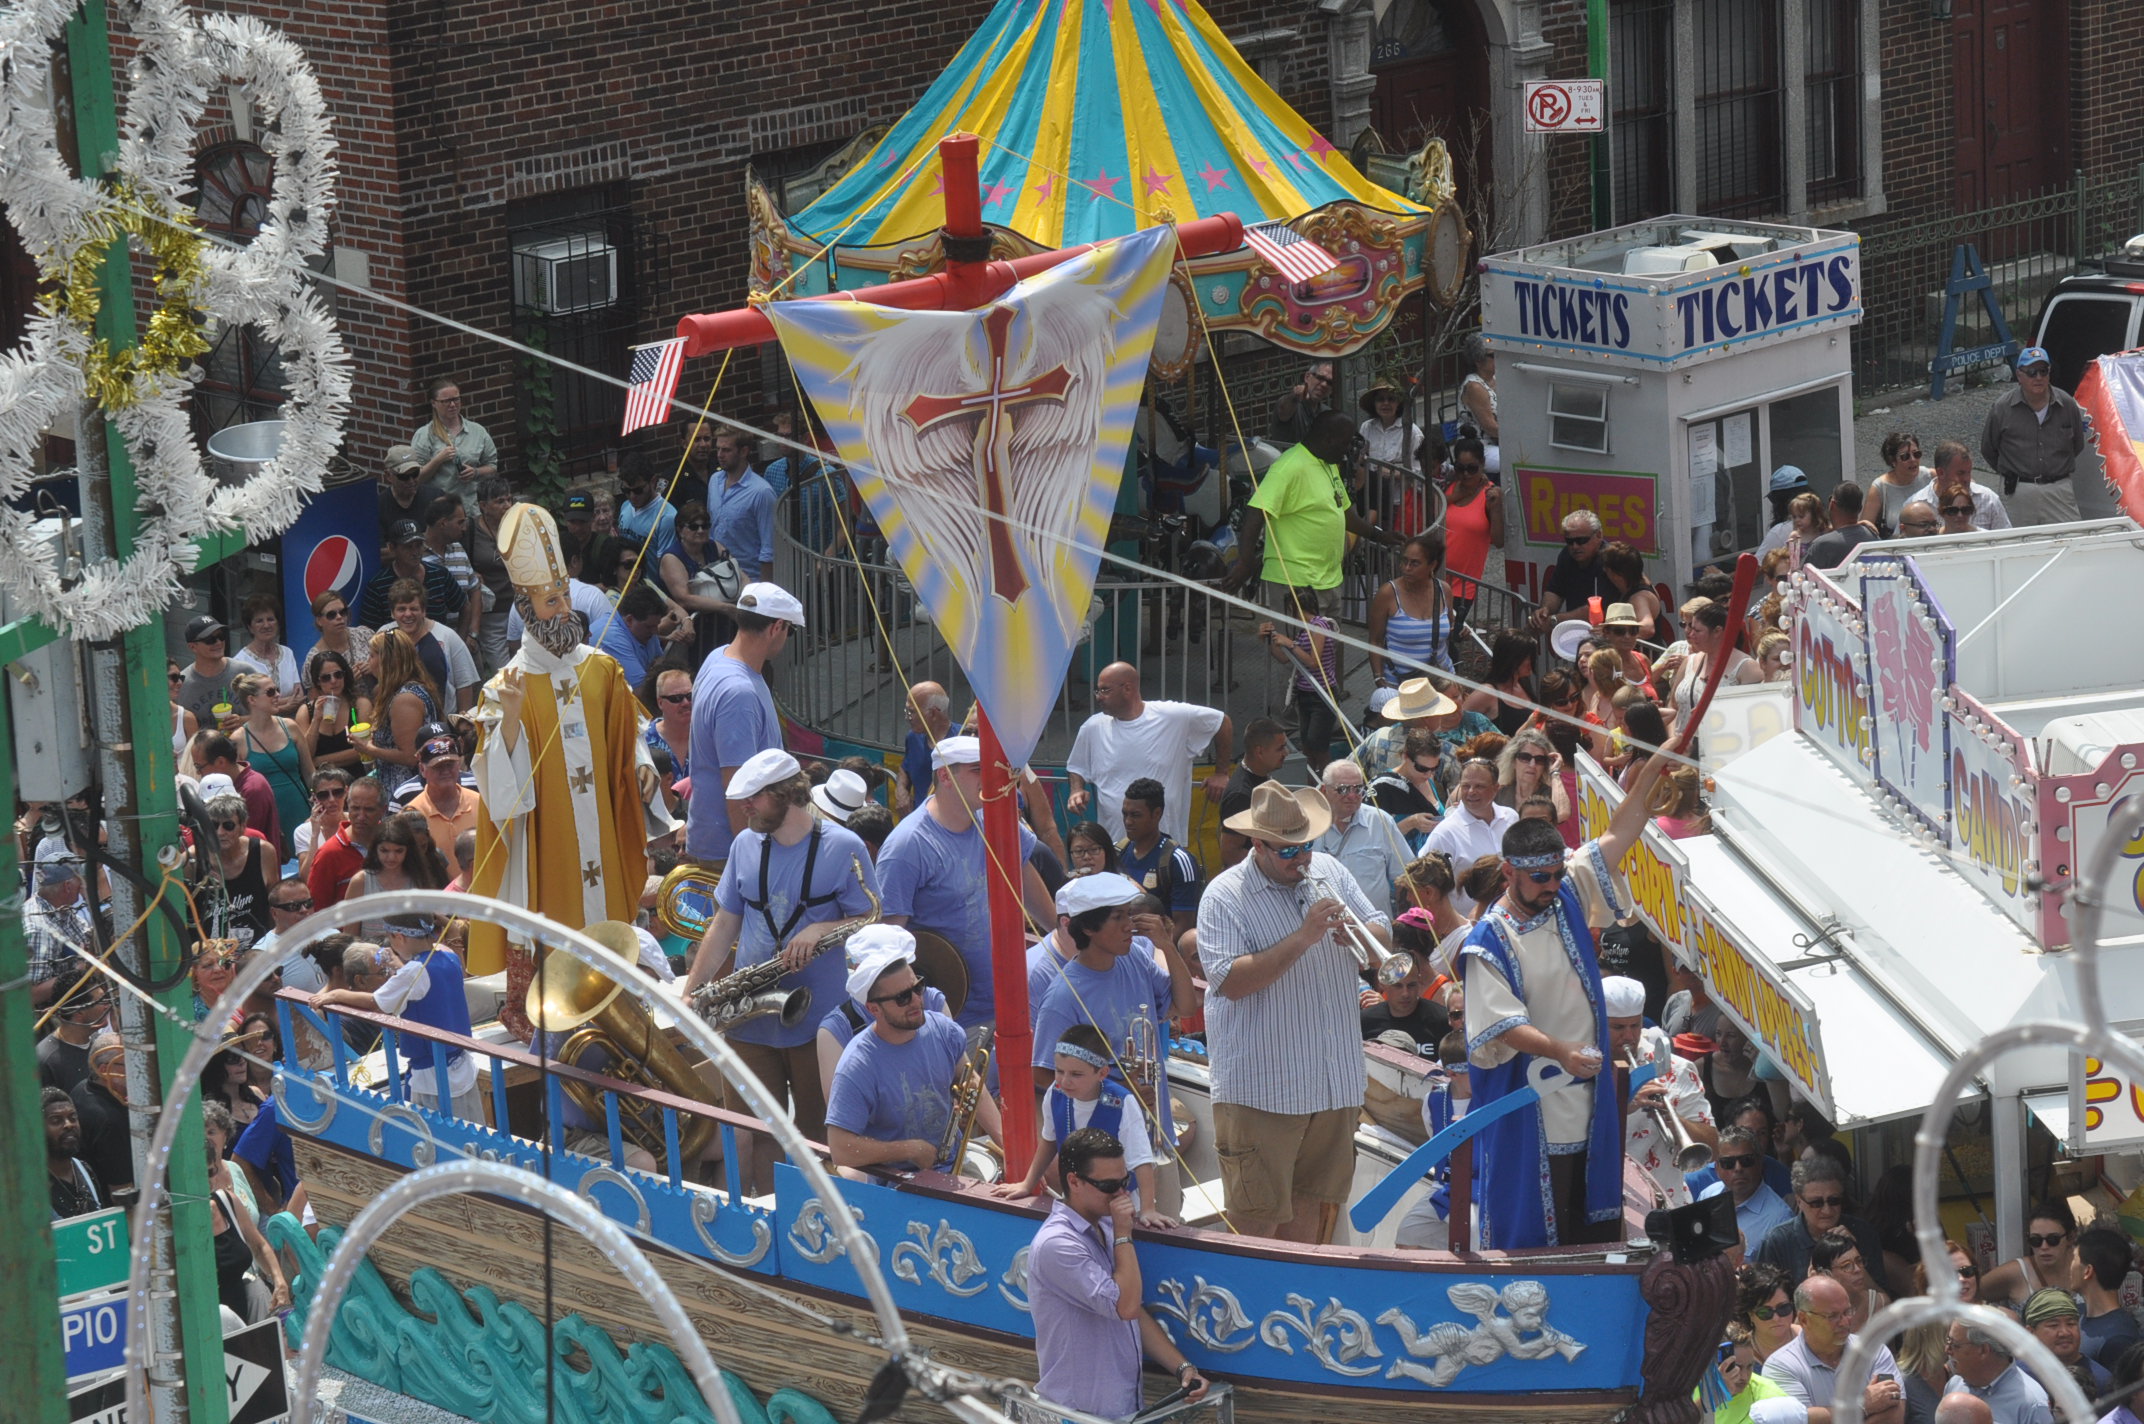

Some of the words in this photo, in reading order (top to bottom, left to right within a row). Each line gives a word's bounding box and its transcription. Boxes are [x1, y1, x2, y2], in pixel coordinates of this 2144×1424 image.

[1377, 42, 1401, 59] 266
[1514, 280, 1631, 348] TICKETS
[1677, 255, 1853, 348] TICKETS
[1951, 351, 1981, 367] POLICE
[1984, 345, 2006, 360] DEPT
[1800, 616, 1871, 770] COTTON
[1953, 746, 2033, 899] CANDY
[1703, 916, 1756, 1031] CANDY
[1757, 970, 1814, 1093] APPLES
[87, 1219, 117, 1255] ST
[62, 1306, 118, 1353] PIO
